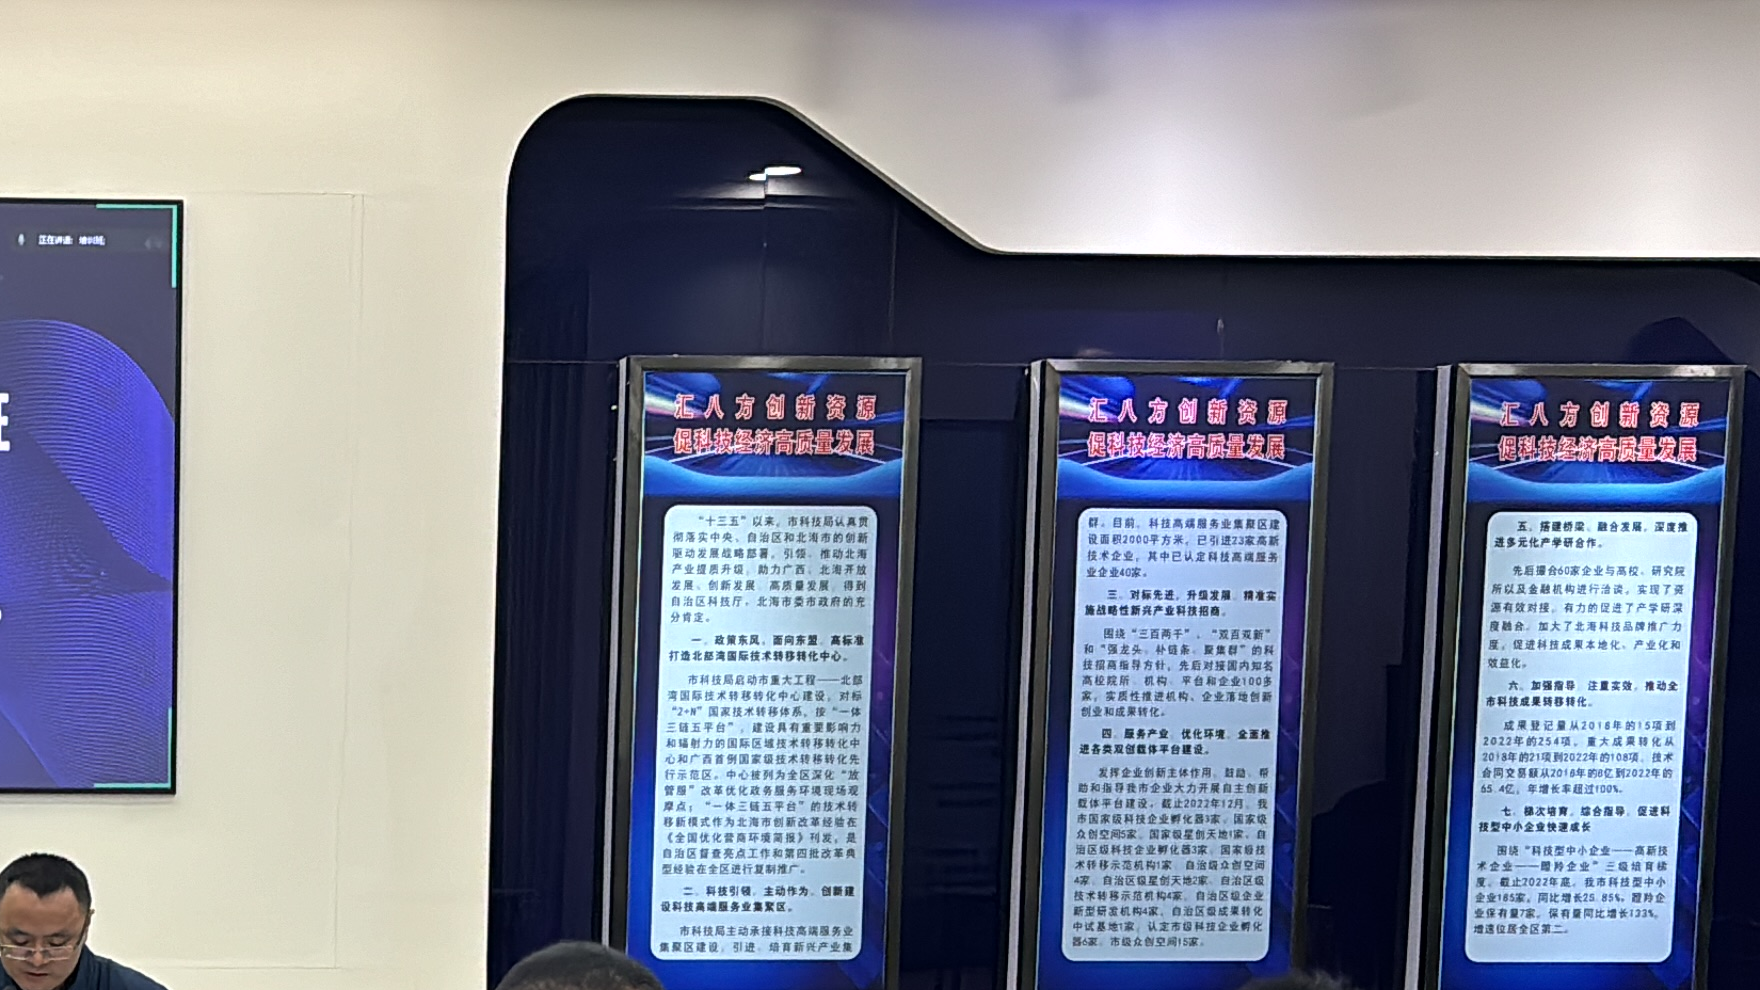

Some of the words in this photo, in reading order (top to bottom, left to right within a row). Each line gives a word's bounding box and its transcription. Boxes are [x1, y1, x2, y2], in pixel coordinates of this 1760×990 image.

[674, 394, 877, 420] 汇八方创新资源
[1088, 397, 1289, 425] 汇八方创新资源
[1499, 401, 1701, 429] 汇八方创新资源
[672, 428, 875, 456] 促科技经济高质量发展
[1087, 431, 1286, 460] 促科技经济高质量发展
[1497, 435, 1698, 463] 促科技经济高质量发展
